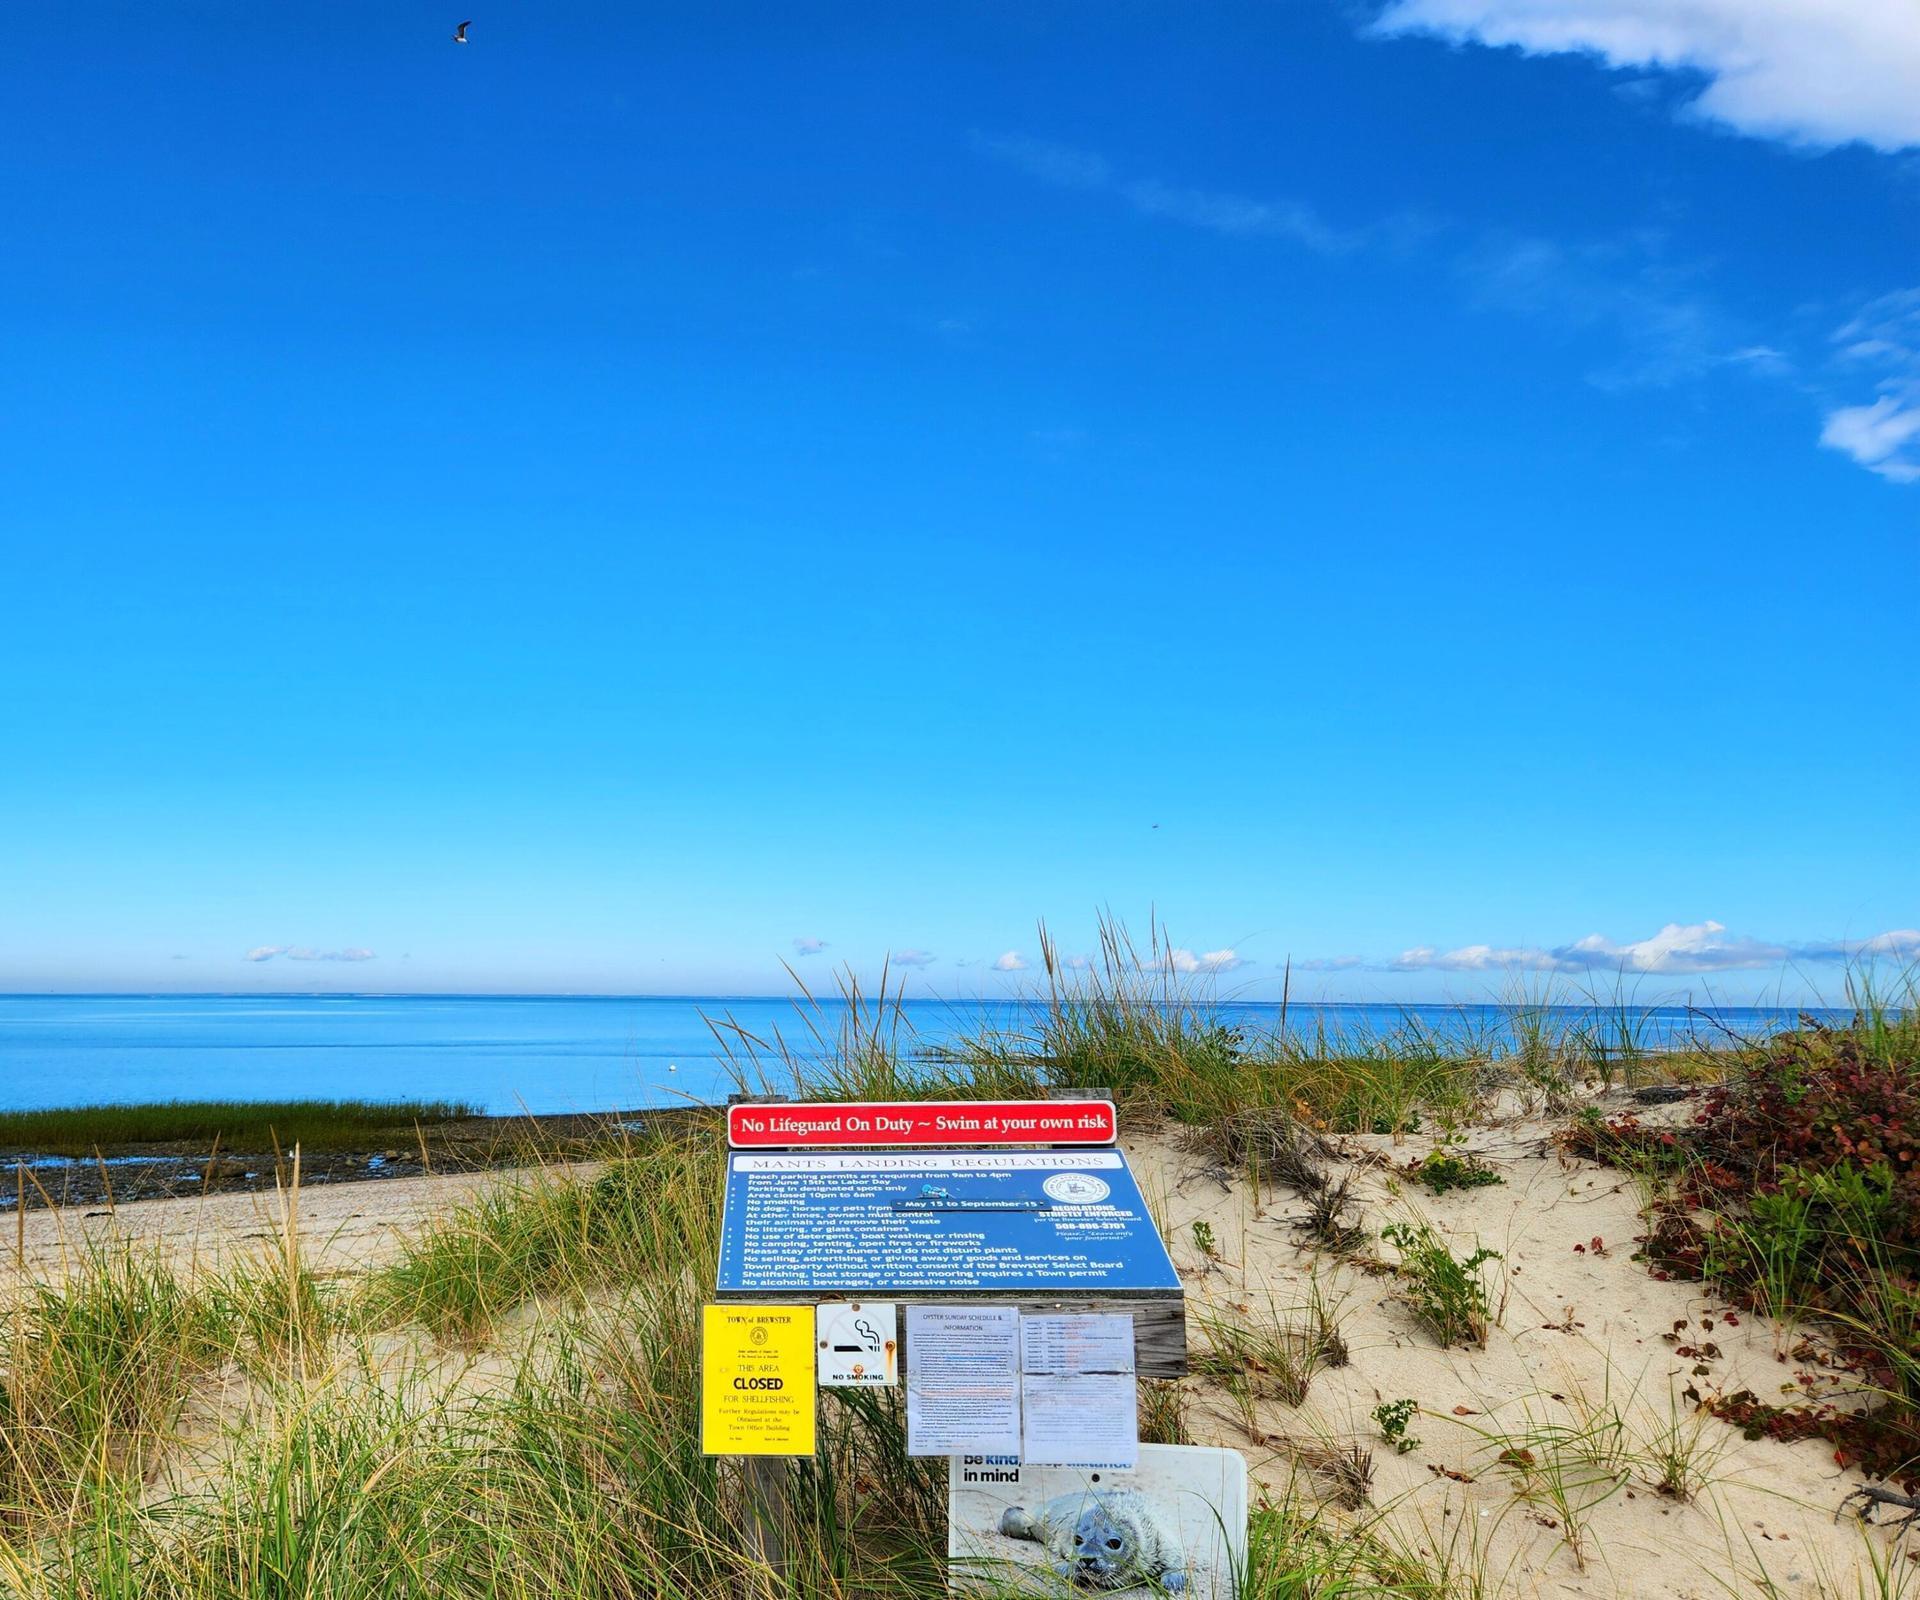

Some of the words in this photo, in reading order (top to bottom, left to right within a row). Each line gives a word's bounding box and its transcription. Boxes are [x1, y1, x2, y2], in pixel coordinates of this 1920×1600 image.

[742, 1119, 764, 1132] No
[770, 1117, 841, 1135] Lifeguard
[846, 1117, 870, 1130] On
[875, 1116, 913, 1134] Duty
[936, 1115, 980, 1129] Swim
[984, 1117, 998, 1129] at
[1001, 1119, 1036, 1133] your
[1040, 1119, 1073, 1129] own
[1078, 1114, 1106, 1128] risk
[840, 1159, 937, 1167] LANDING
[951, 1158, 1103, 1166] REGULATIONS
[743, 1271, 808, 1279] Shellfishing,
[841, 1271, 881, 1279] storage
[1069, 1270, 1107, 1278] permit
[734, 1378, 783, 1390] CLOSED
[964, 1456, 983, 1464] be
[964, 1468, 978, 1482] in
[980, 1468, 1018, 1482] mind
